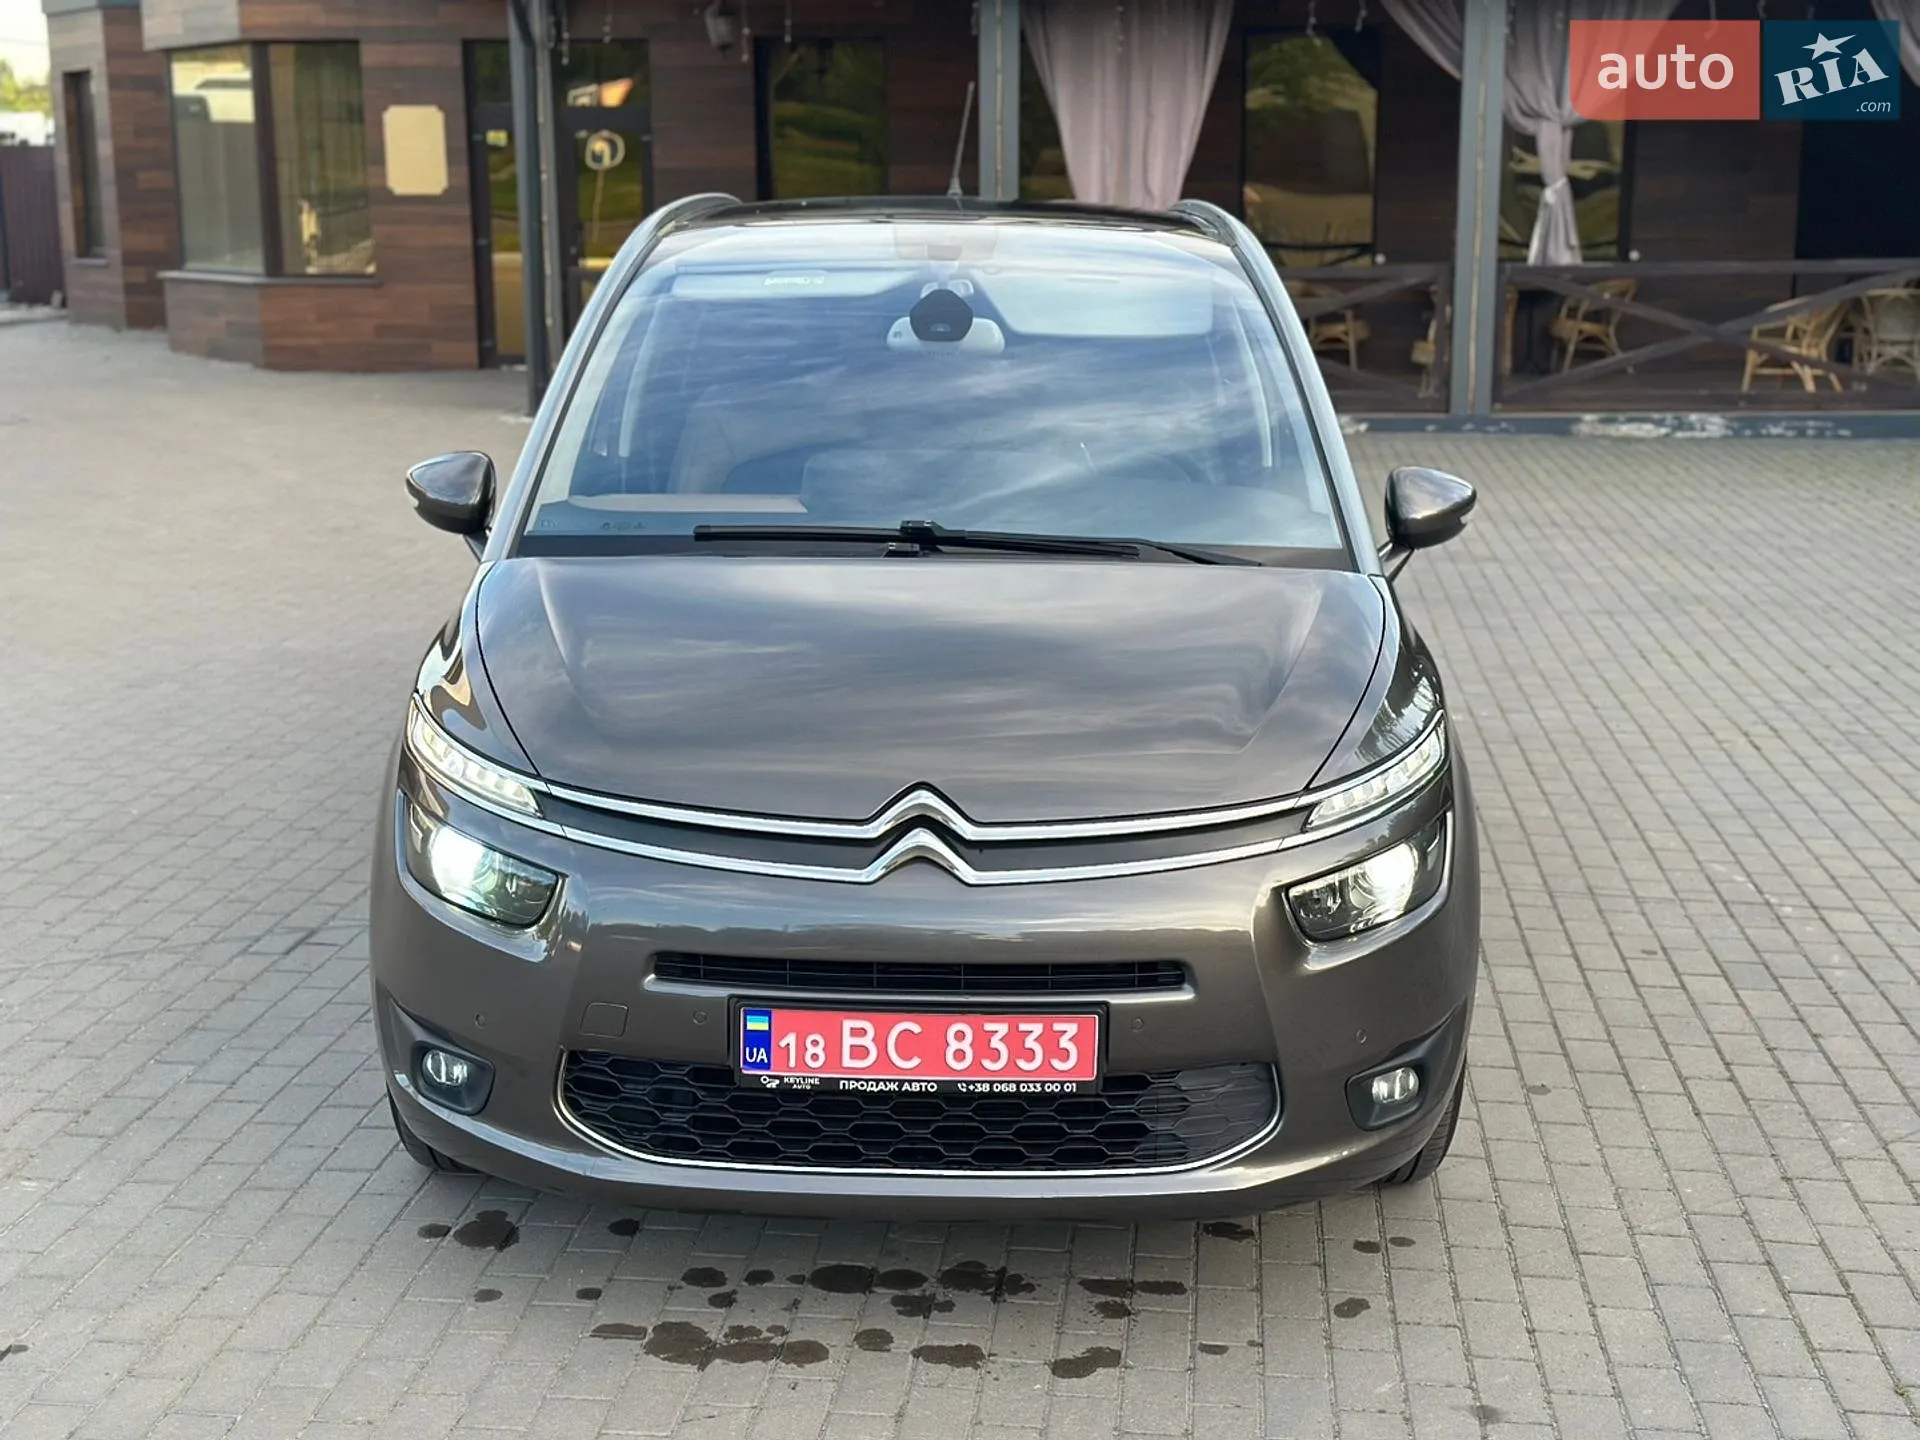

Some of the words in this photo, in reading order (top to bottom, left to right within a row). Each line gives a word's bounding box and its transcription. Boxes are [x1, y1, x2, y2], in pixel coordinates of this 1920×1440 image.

[778, 1031, 827, 1070] 18
[841, 1019, 923, 1070] BC
[944, 1021, 1079, 1072] 8333
[745, 1047, 768, 1063] UA
[783, 1076, 820, 1086] KEYLINE
[839, 1080, 900, 1093] ПРОДАЖ
[901, 1081, 938, 1093] АВТО
[968, 1082, 990, 1093] +38
[993, 1082, 1017, 1093] 068
[1019, 1082, 1042, 1093] 033
[1044, 1082, 1062, 1093] 00
[1063, 1082, 1077, 1093] 01
